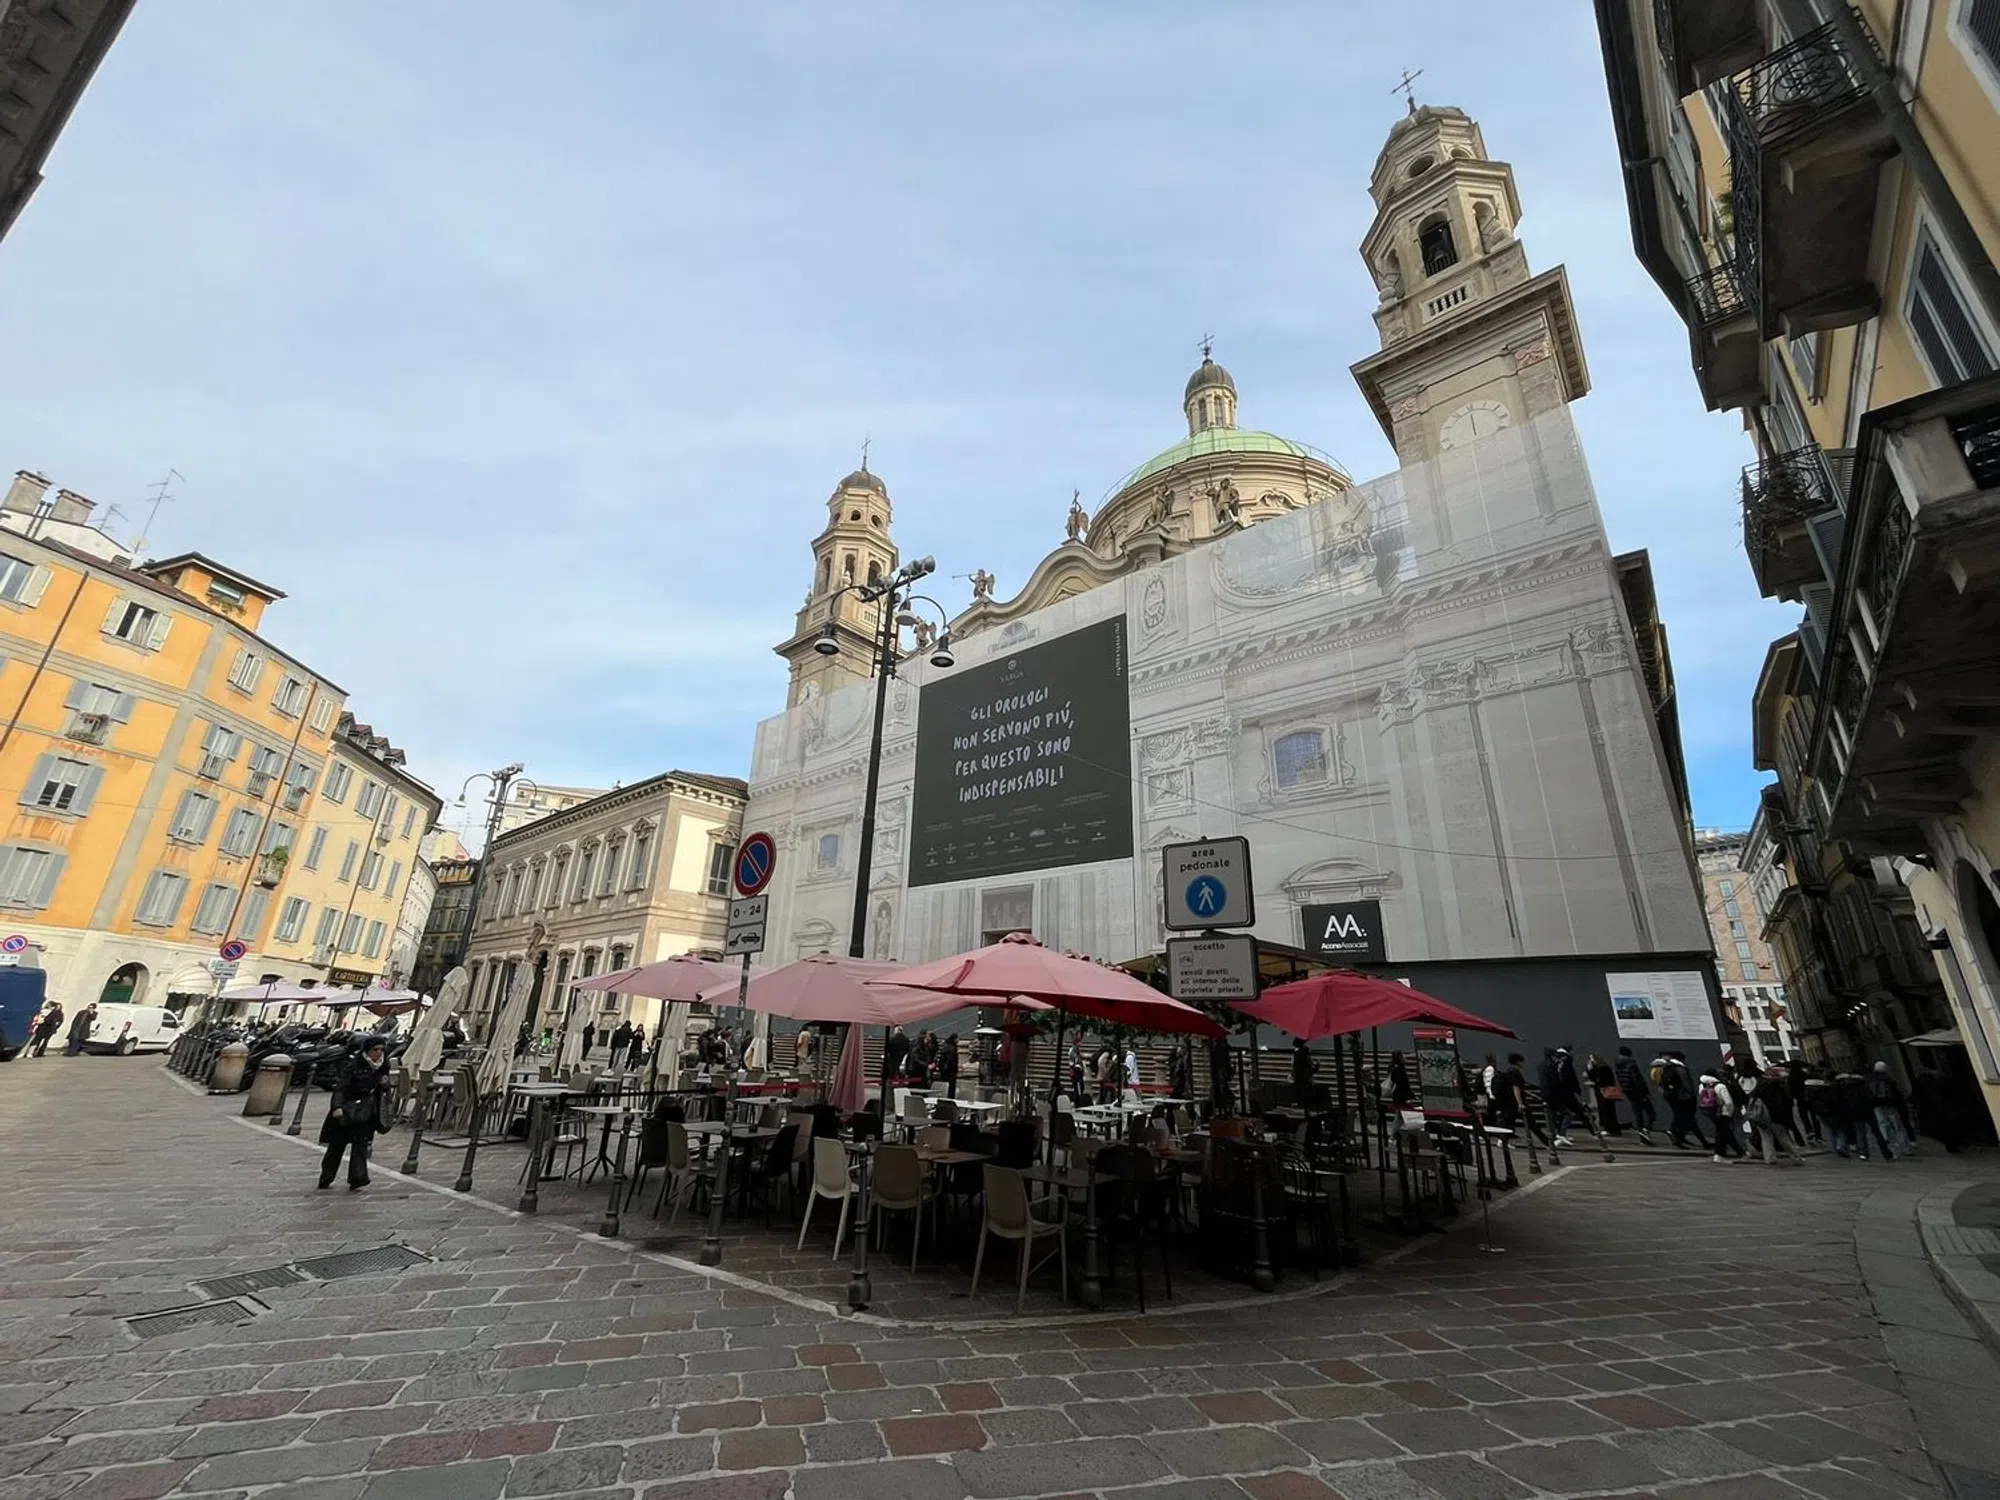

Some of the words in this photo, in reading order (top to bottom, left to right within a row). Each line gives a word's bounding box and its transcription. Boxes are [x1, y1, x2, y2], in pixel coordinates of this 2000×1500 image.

[970, 704, 991, 720] GLI
[995, 687, 1049, 713] OROLOGI
[953, 732, 979, 750] NON
[982, 715, 1040, 743] SERVONO
[955, 760, 979, 776] PER
[981, 745, 1031, 770] QUESTO
[1037, 736, 1071, 757] SONO
[959, 765, 1064, 803] INDISPENSABILI
[1191, 849, 1215, 857] area
[1180, 858, 1230, 873] pedonale
[733, 907, 740, 919] 0
[749, 904, 761, 916] 24
[1193, 942, 1226, 951] eccetto
